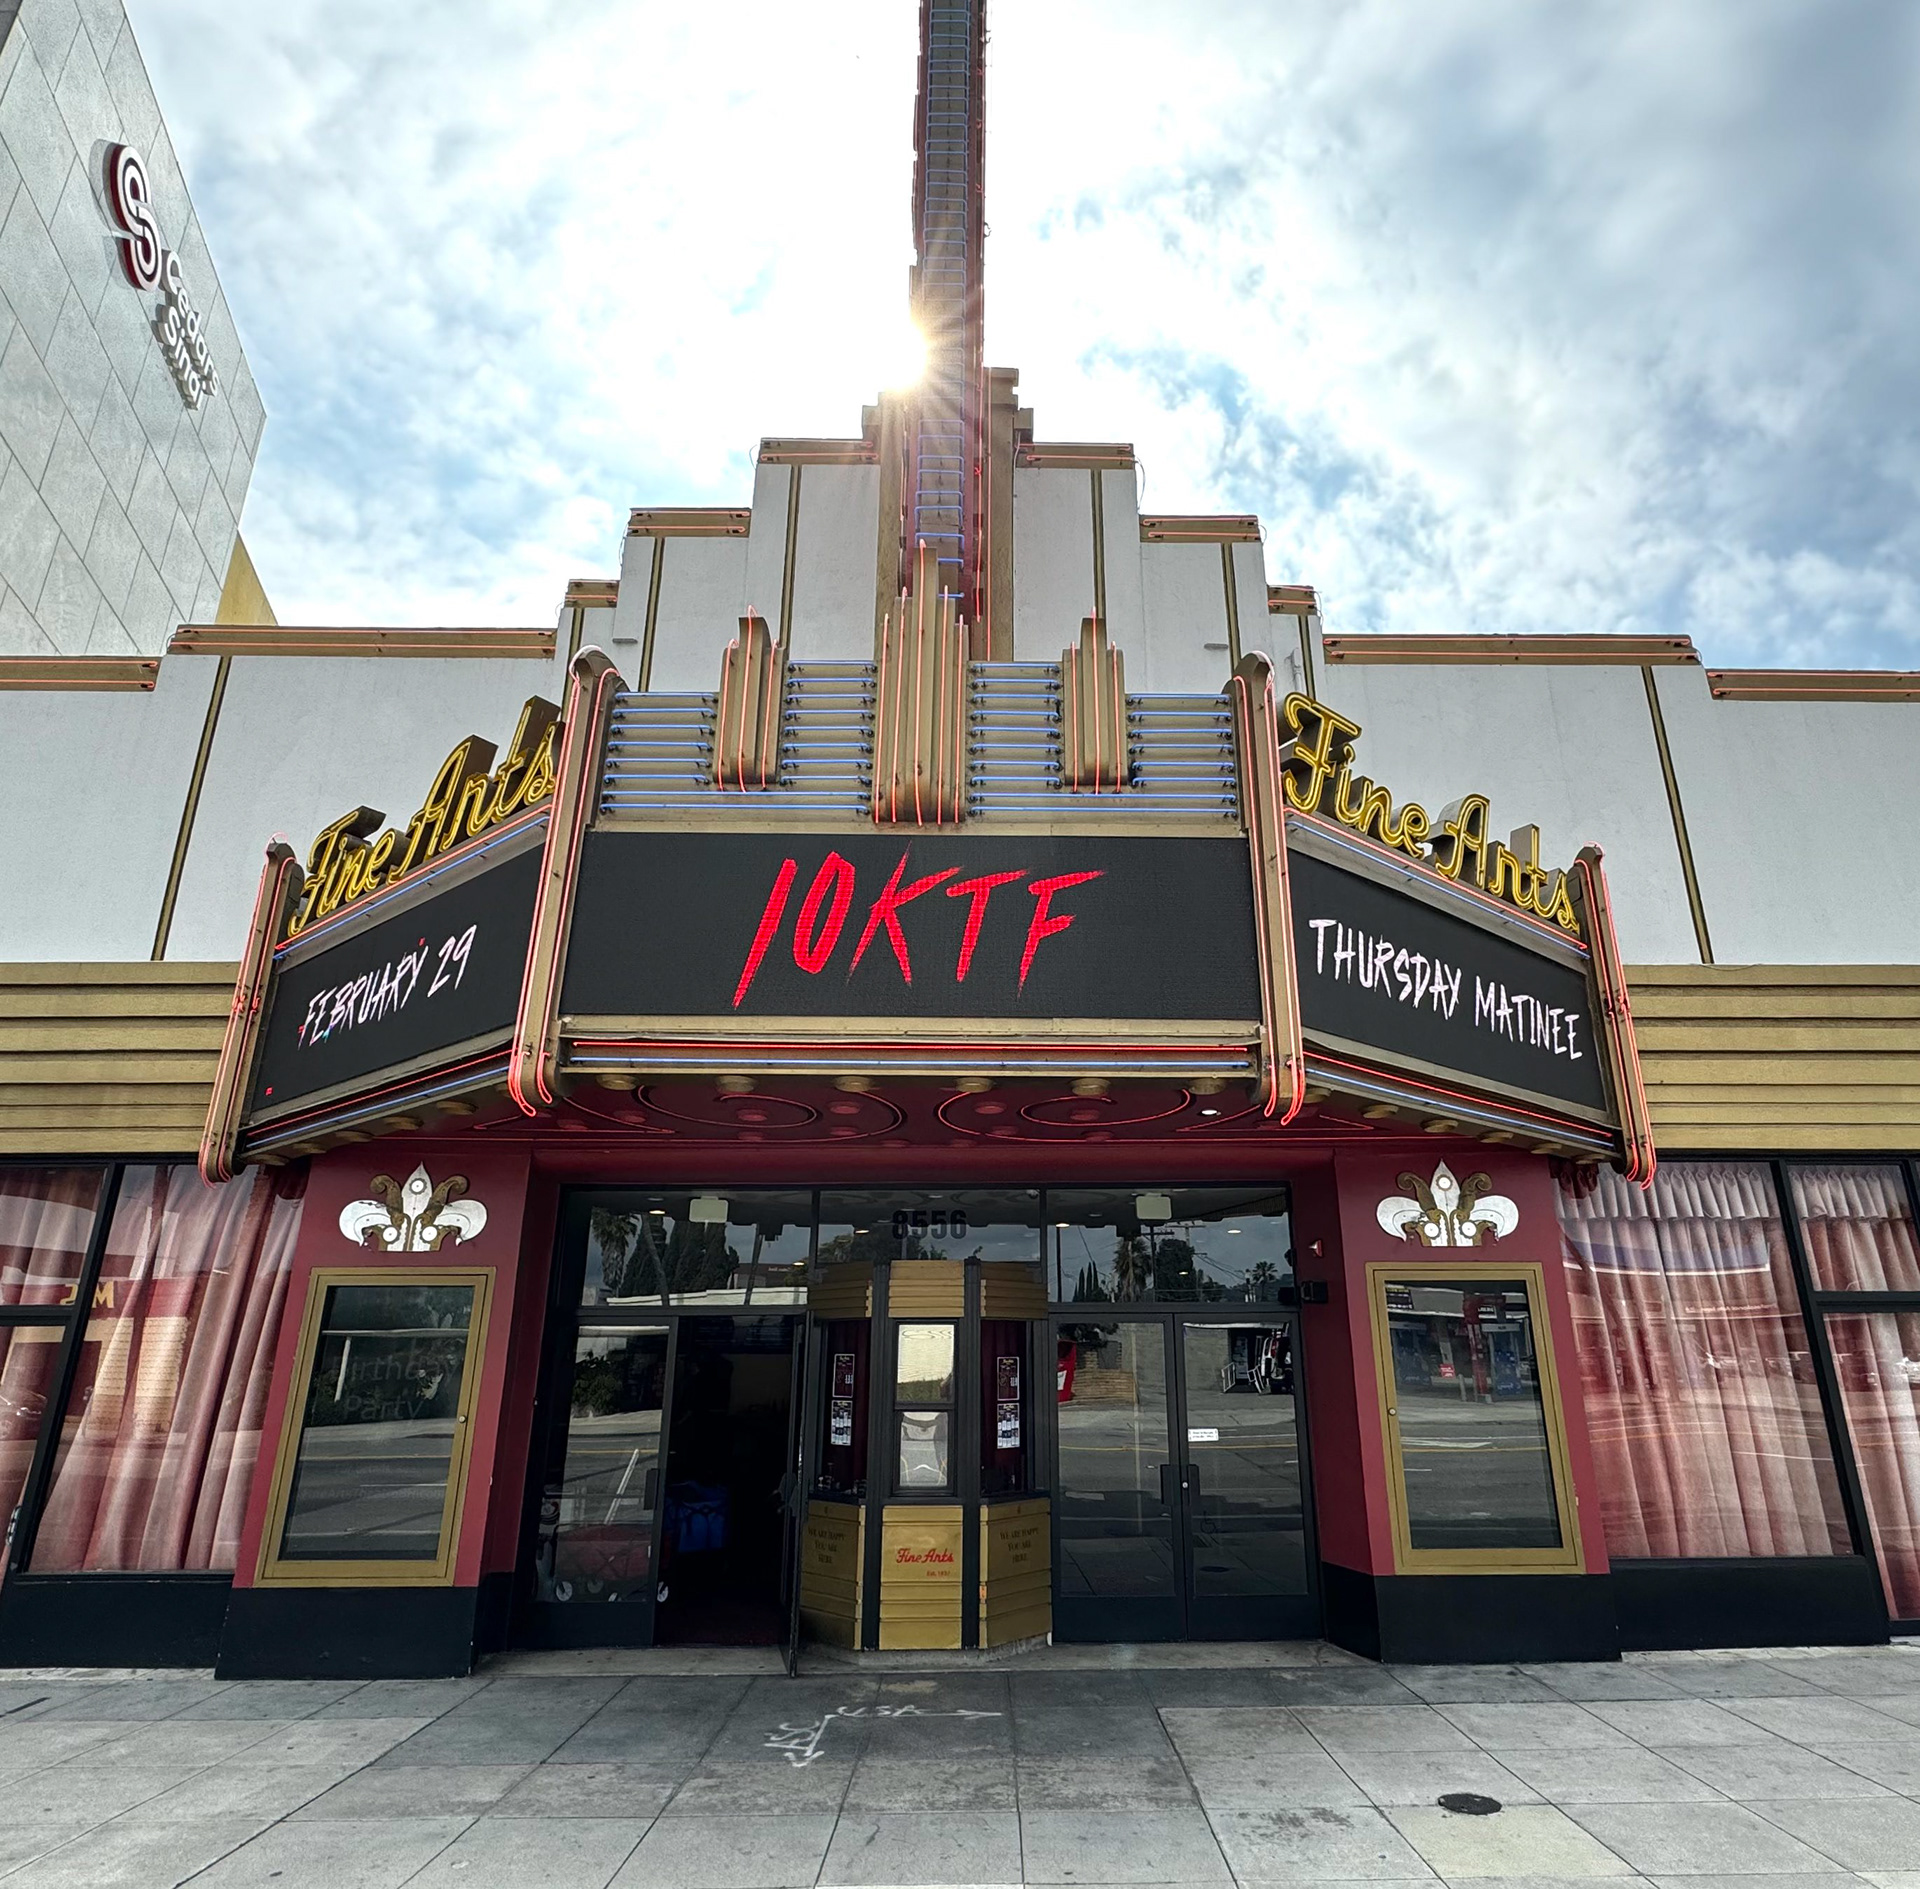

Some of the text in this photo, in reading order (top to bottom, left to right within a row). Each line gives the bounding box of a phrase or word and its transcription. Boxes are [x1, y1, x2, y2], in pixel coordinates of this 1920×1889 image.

[165, 249, 220, 398] Cedars
[287, 696, 557, 938] Fine Arts
[1282, 692, 1581, 933] Fine Arts
[297, 923, 478, 1053] FEBRUARY 29
[732, 840, 1106, 1010] 10KTF
[1308, 918, 1584, 1061] THURSDAY MATINEE
[891, 1208, 967, 1240] 8556
[895, 1547, 955, 1564] Fine Arts
